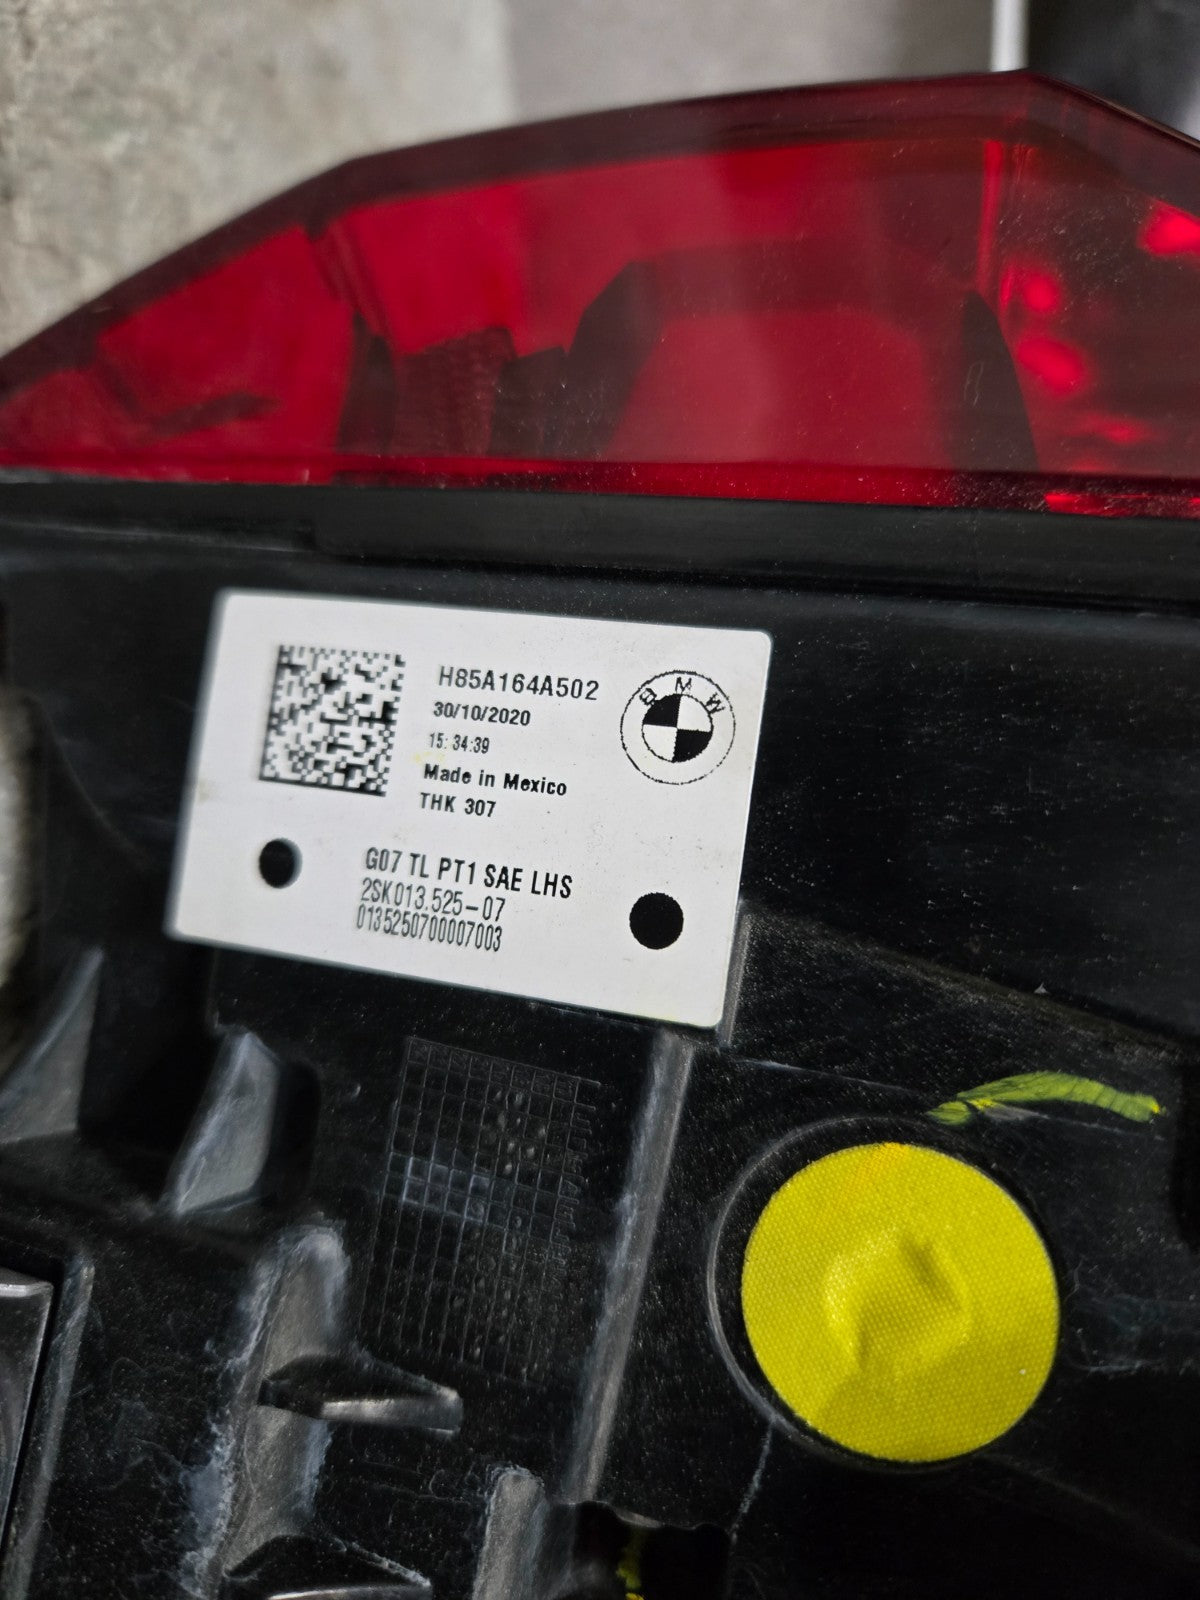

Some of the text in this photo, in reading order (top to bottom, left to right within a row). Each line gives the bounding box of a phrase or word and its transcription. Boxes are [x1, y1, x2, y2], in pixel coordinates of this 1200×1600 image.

[438, 665, 599, 700] H85A164A502
[433, 702, 531, 726] 30/10/2020
[424, 764, 567, 796] Made in Mexico
[420, 792, 496, 818] THK 307
[365, 846, 573, 899] G07 TL PT1 SAE LHS
[356, 903, 503, 952] 0135250700007003
